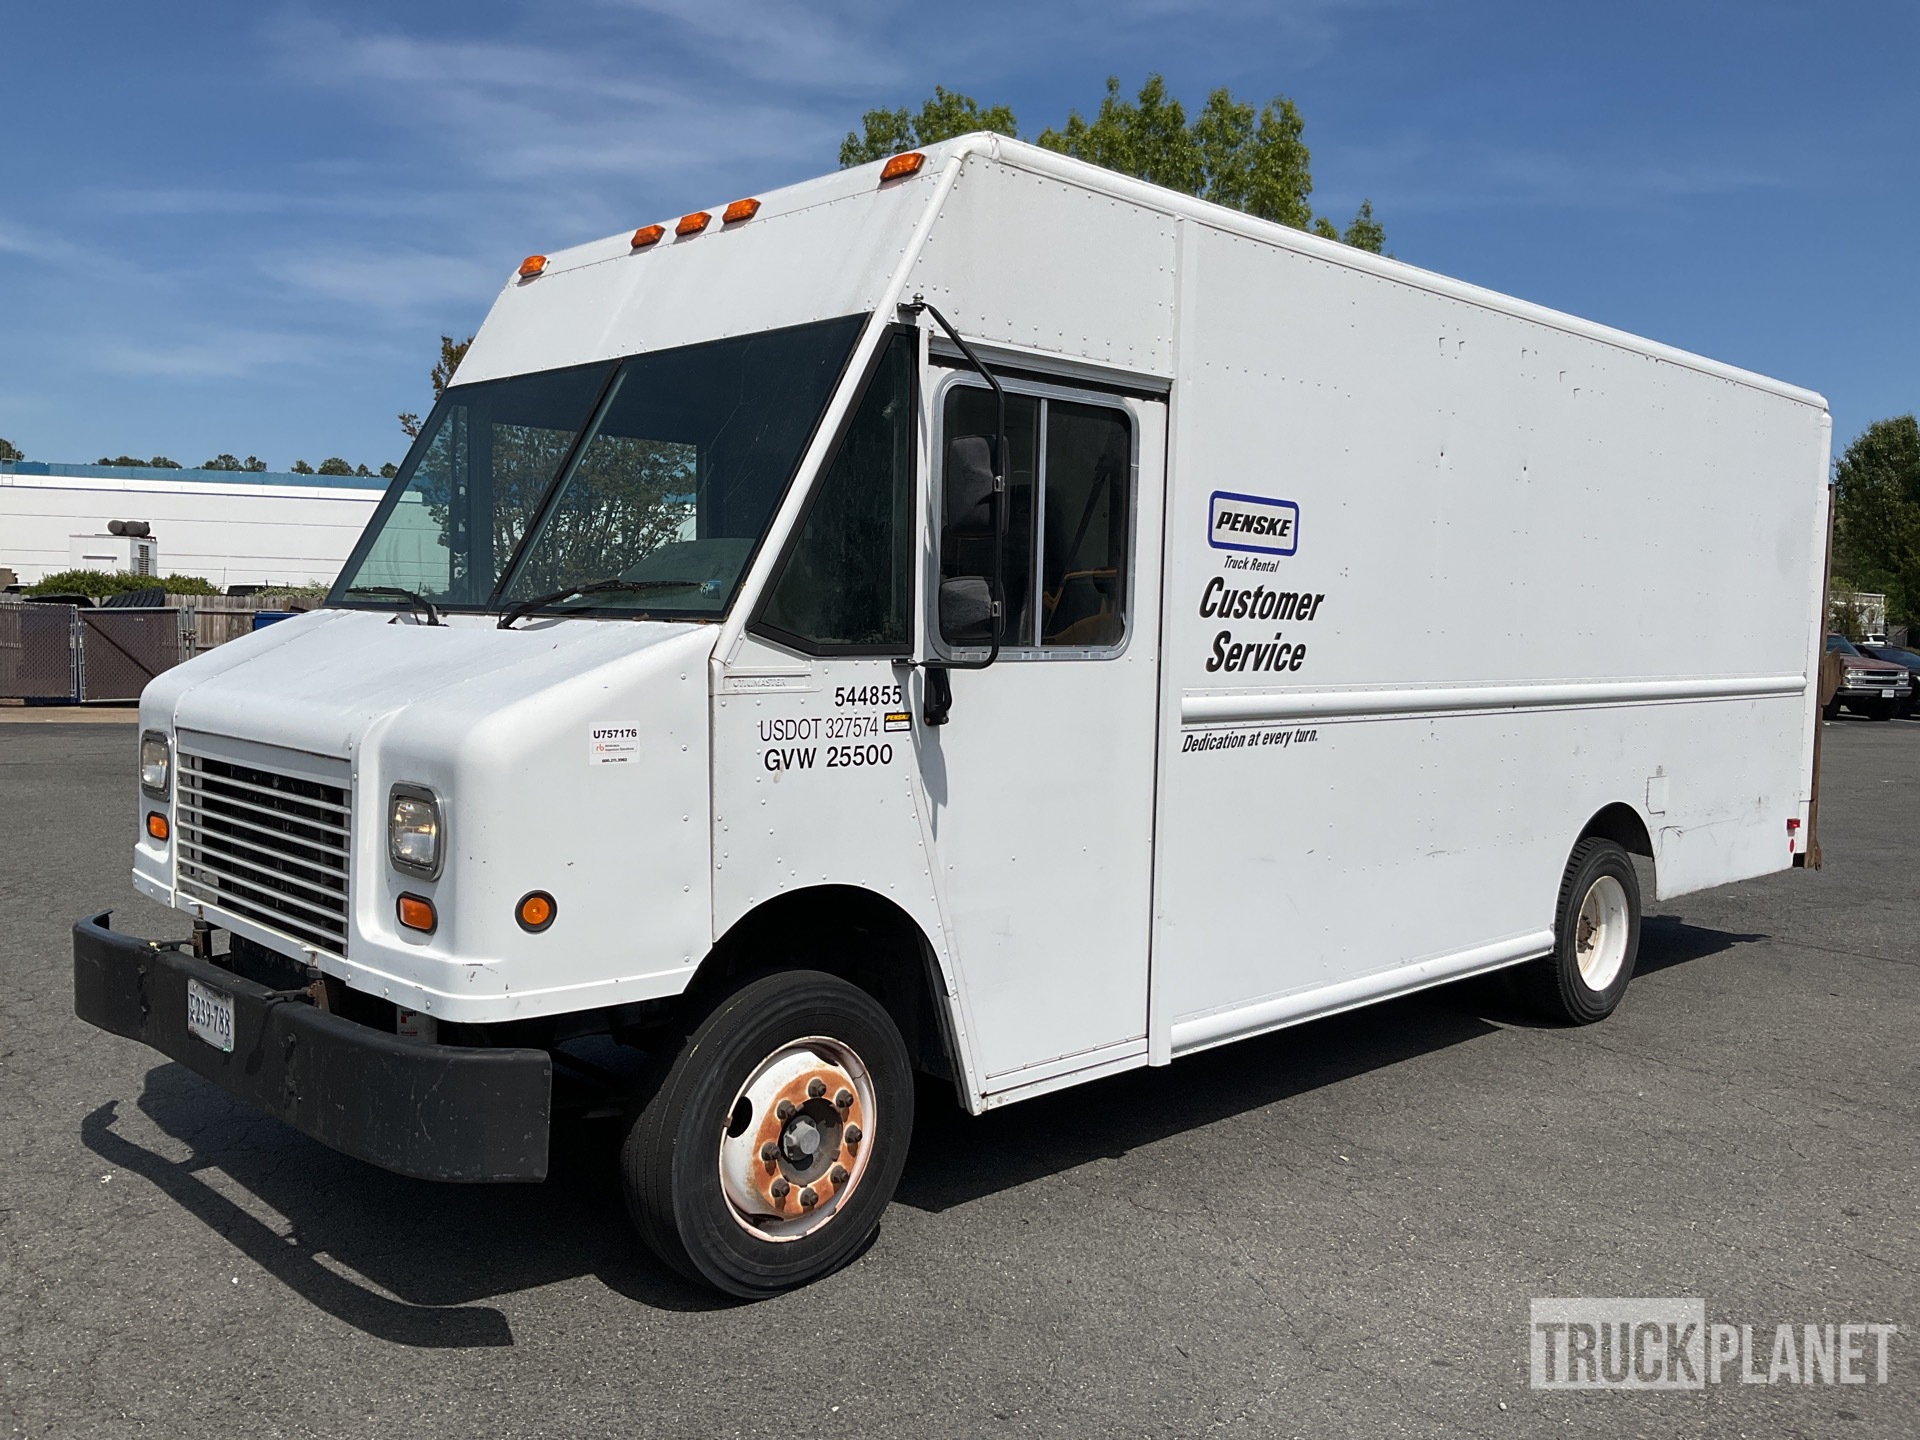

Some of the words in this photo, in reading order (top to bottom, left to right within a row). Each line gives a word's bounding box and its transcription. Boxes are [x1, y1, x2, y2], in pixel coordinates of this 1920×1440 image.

[1215, 511, 1293, 537] PENSKE
[1223, 555, 1250, 571] Truck
[1250, 557, 1281, 573] Rental
[1199, 576, 1326, 621] Customer
[1205, 630, 1307, 673] Service
[834, 685, 902, 707] 544855
[593, 728, 638, 739] U757176
[760, 718, 822, 742] USDOT
[825, 716, 879, 739] 327574
[1181, 731, 1247, 753] Dedication
[1247, 731, 1262, 747] at
[1262, 730, 1293, 748] every
[1293, 728, 1319, 744] turn.
[764, 747, 817, 771] GVW
[826, 744, 893, 768] 25500
